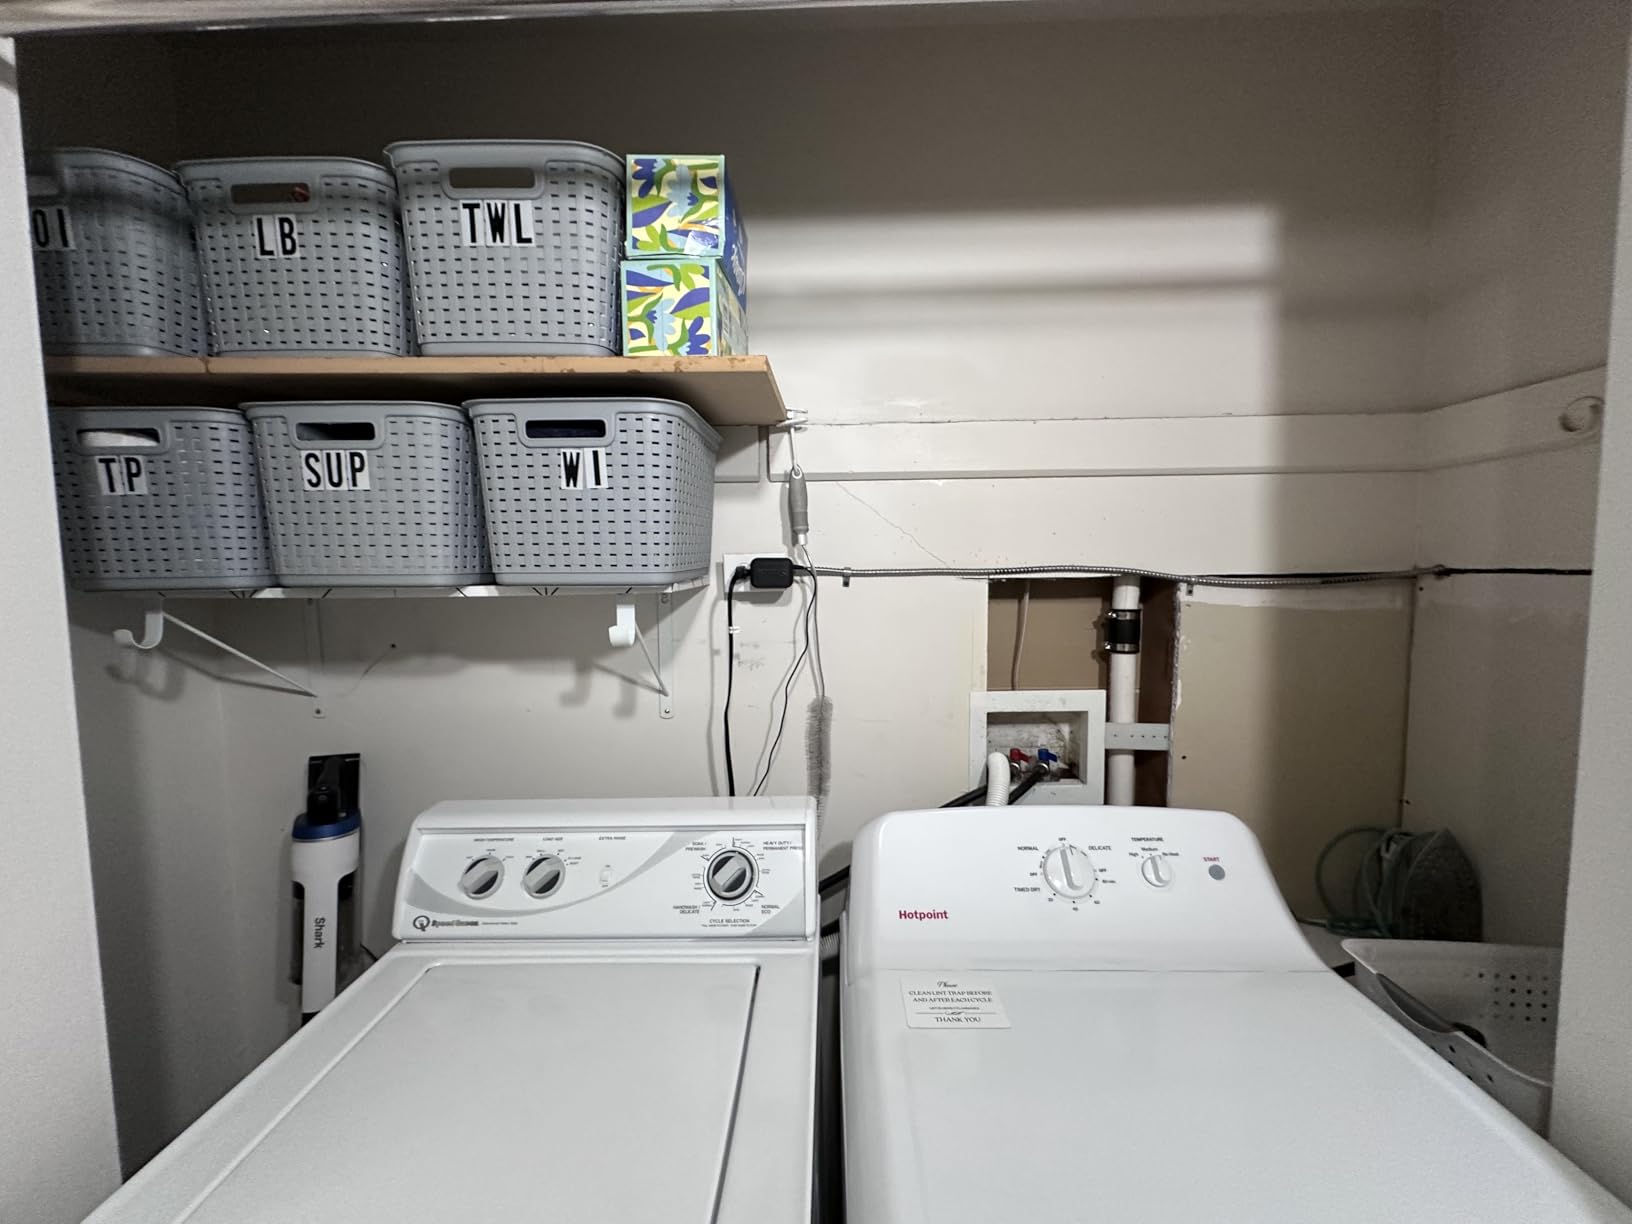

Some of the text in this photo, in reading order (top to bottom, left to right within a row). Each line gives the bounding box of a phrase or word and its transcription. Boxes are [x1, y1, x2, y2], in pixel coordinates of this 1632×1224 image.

[256, 216, 297, 256] LB
[462, 203, 532, 244] TWL
[99, 457, 142, 493] TP
[304, 452, 366, 488] SUP
[562, 450, 601, 488] WI
[313, 916, 326, 949] Shark
[898, 909, 949, 921] Hotpoint
